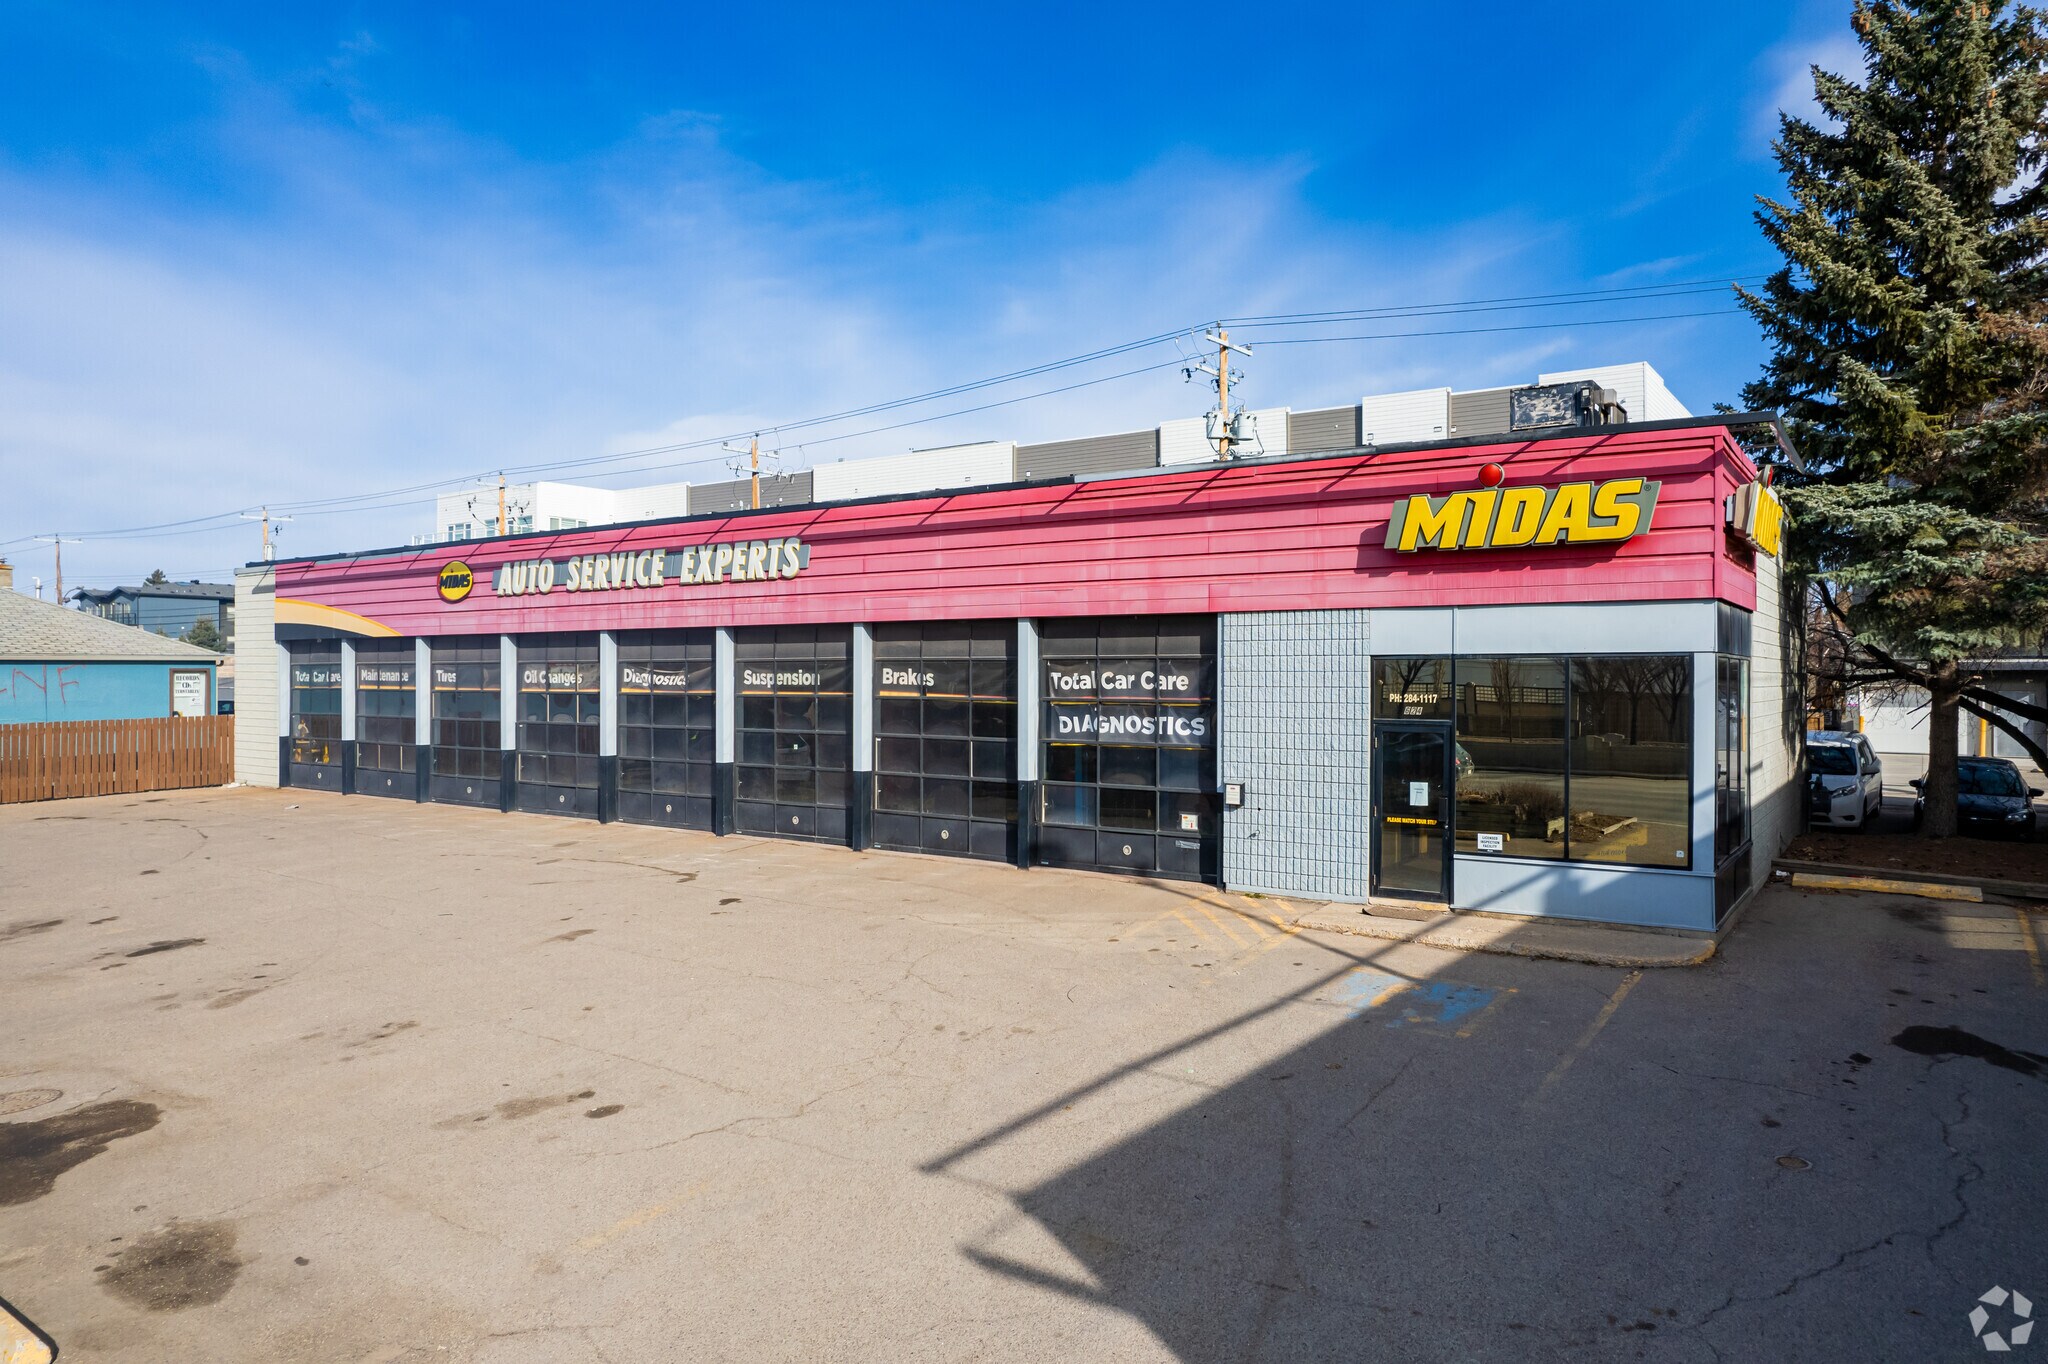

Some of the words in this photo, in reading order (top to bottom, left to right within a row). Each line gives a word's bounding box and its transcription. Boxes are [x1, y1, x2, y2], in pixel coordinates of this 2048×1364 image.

[1397, 476, 1645, 553] MIDAS
[496, 558, 555, 597] AUTO
[566, 548, 667, 593] SERVICE
[680, 537, 802, 587] EXPERTS
[440, 573, 471, 589] MIDAS
[295, 670, 310, 682] Tota
[436, 669, 457, 683] Tires
[524, 670, 537, 684] Oil
[743, 669, 820, 688] Suspension
[882, 667, 935, 687] Brakes
[1051, 670, 1097, 690] Total
[1101, 671, 1135, 690] Car
[1140, 671, 1189, 691] Care
[1389, 693, 1402, 703] PH:
[1403, 693, 1438, 704] 284-1117
[1059, 714, 1206, 736] DIAGNOSTICS
